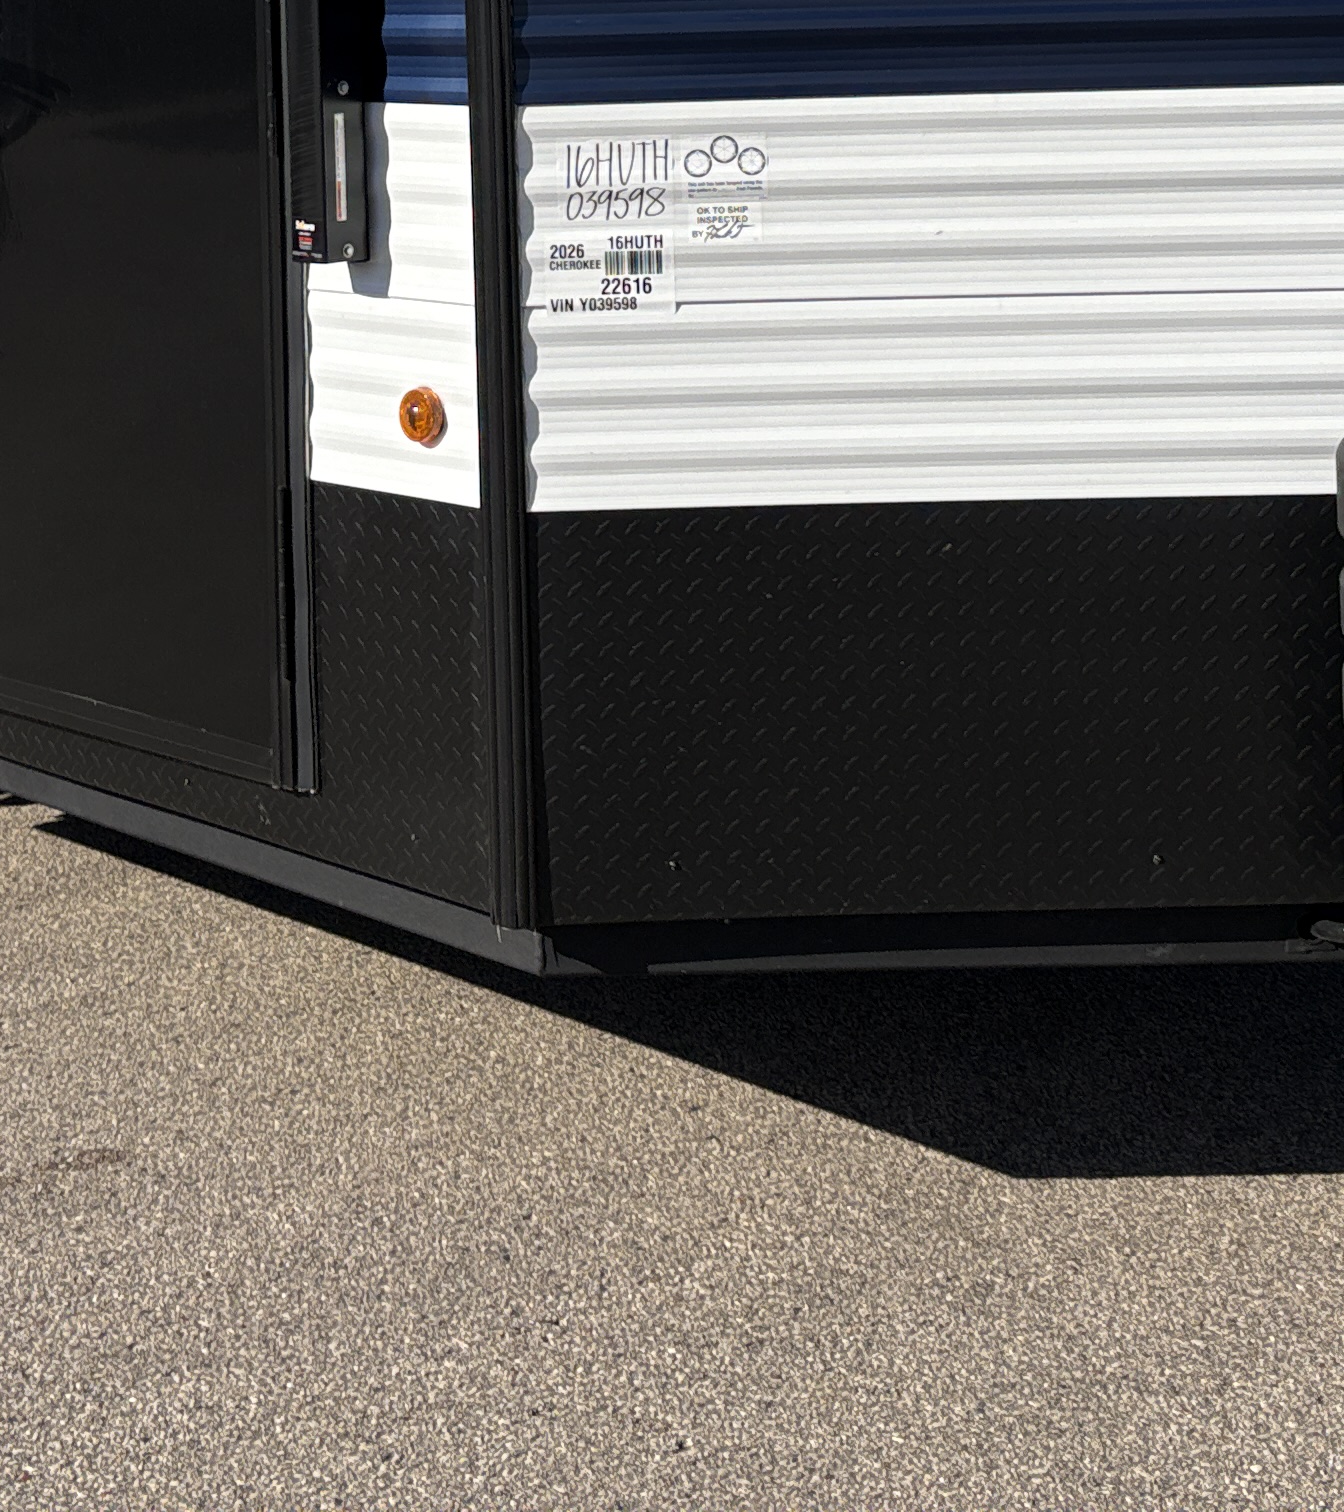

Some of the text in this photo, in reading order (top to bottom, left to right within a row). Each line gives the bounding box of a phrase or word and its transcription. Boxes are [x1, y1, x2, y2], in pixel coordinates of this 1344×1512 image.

[566, 139, 669, 189] 16HUTH
[566, 187, 667, 221] 039598
[696, 205, 749, 215] OK TO SHIP
[696, 215, 749, 224] INSPECTED
[607, 234, 663, 250] 16HUTH
[692, 230, 704, 239] BY
[549, 244, 585, 259] 2026
[549, 259, 601, 271] CHEROKEE
[601, 276, 653, 295] 22616
[550, 296, 638, 313] VIN Y039598
